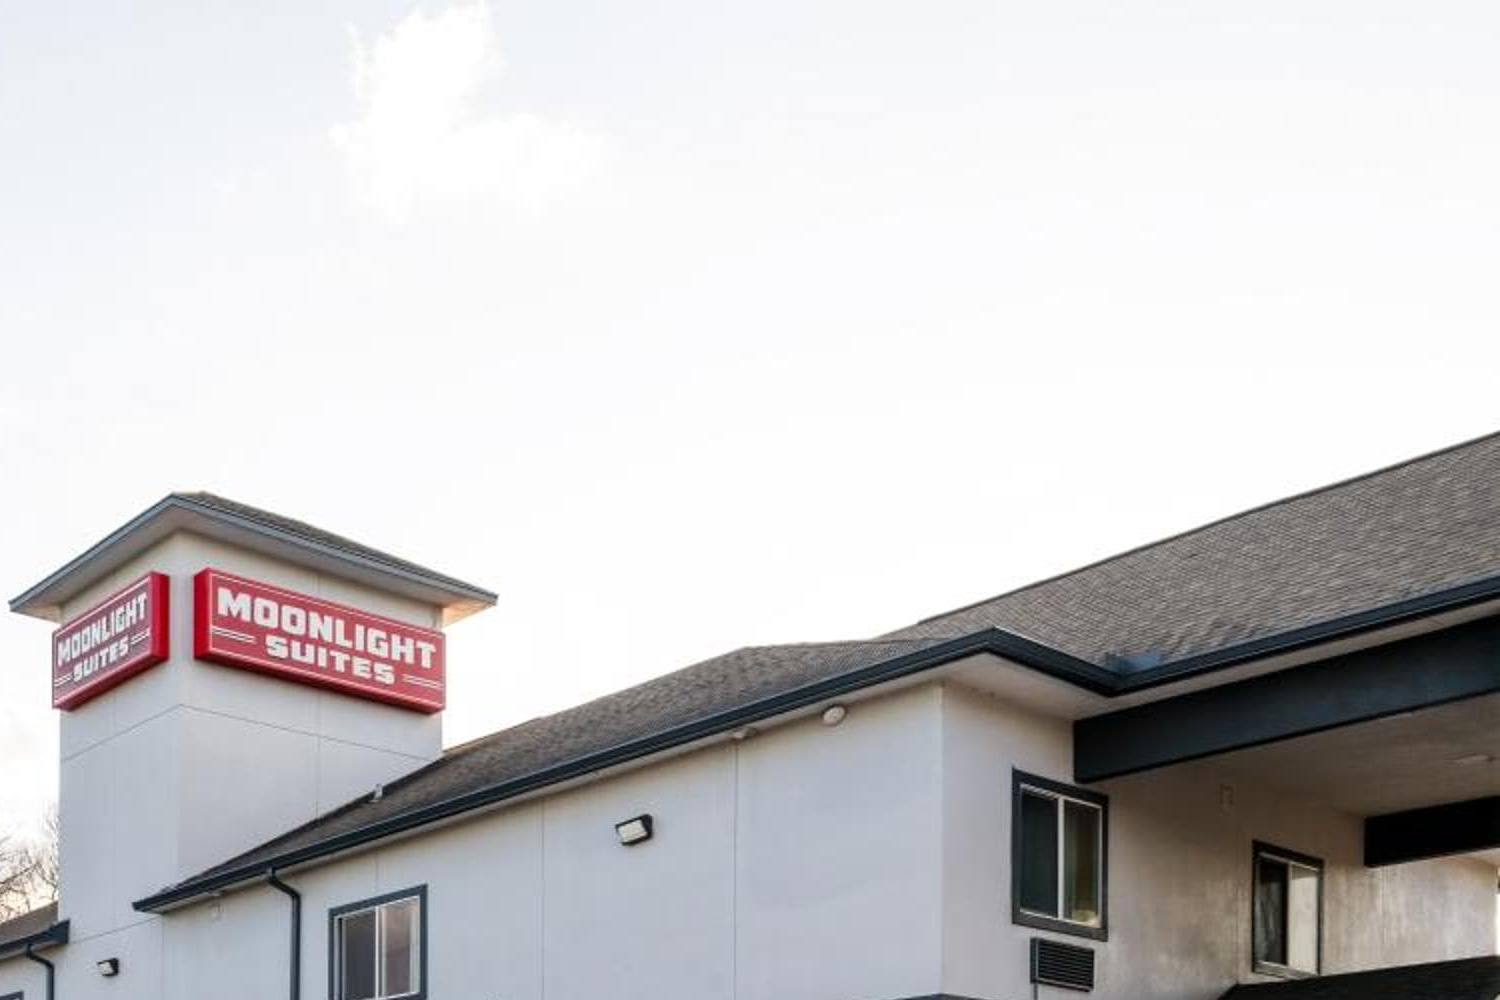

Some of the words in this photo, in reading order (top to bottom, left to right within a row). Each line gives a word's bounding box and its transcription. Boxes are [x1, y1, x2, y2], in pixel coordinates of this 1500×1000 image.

[58, 592, 147, 667] MOONLIGHT
[217, 587, 436, 668] MOONLIGHT
[74, 636, 129, 682] SUITES
[265, 634, 395, 684] SUITES
